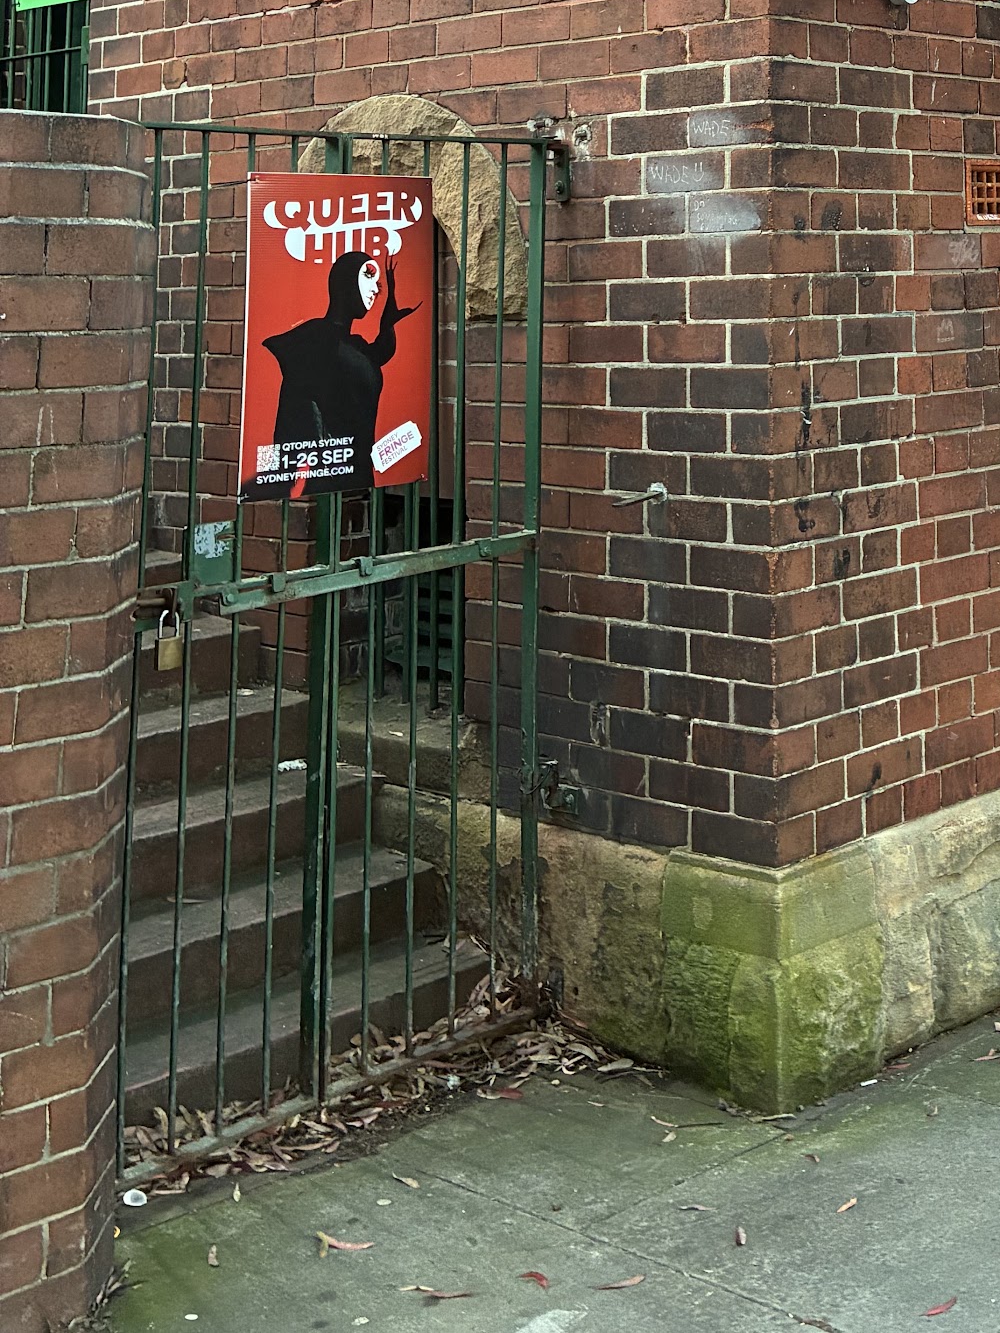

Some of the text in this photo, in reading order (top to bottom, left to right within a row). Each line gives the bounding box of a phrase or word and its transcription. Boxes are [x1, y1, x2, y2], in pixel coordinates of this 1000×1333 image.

[267, 191, 420, 233] QUEER
[300, 227, 396, 264] HUB
[282, 437, 354, 452] QTOPIA SYDNEY
[376, 432, 398, 451] SYDNEY
[378, 430, 415, 461] FRINGE
[322, 448, 354, 465] SEP
[381, 446, 408, 467] FESTIVAL
[256, 466, 354, 485] SYDNEYFRINGE.COM
